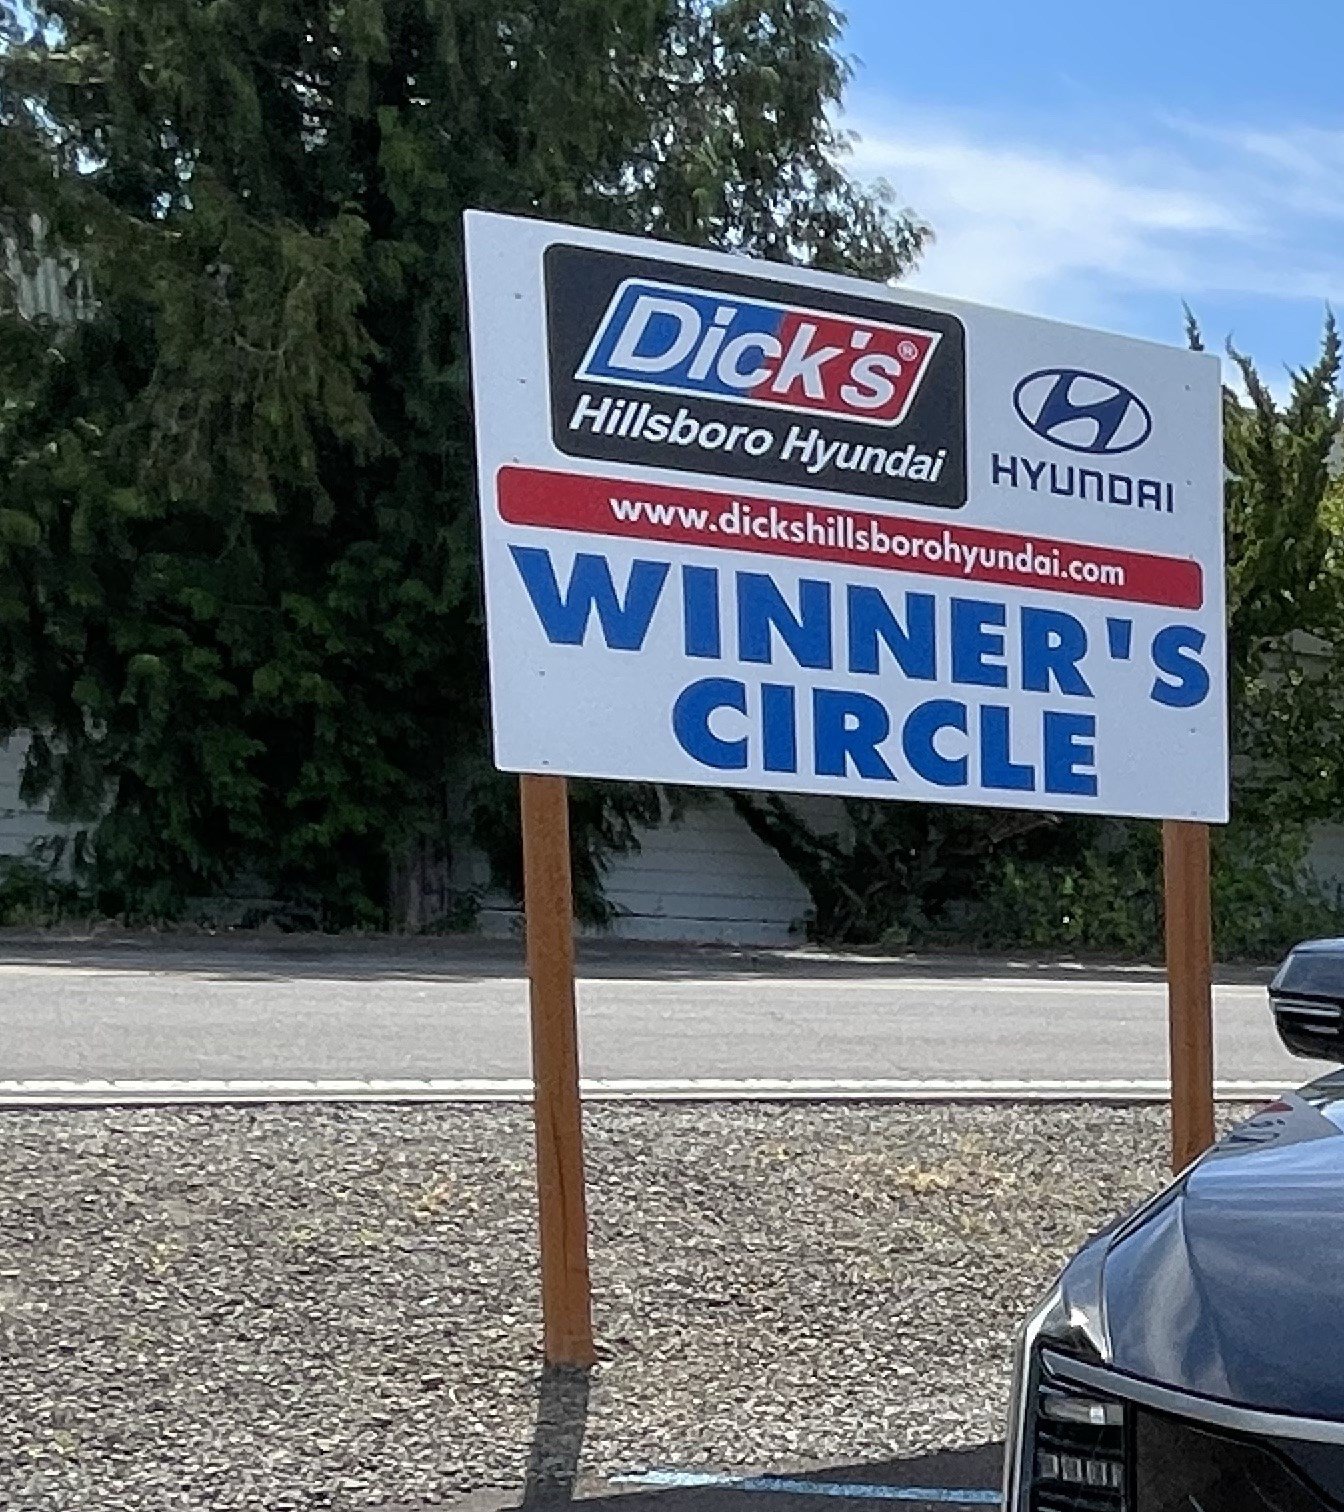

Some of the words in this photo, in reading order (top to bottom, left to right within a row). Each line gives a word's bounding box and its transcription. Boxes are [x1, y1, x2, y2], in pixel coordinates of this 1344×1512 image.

[608, 294, 902, 409] Dick's
[569, 395, 774, 460] Hillsboro
[780, 426, 947, 484] Hyundai
[992, 453, 1174, 513] HYUNDAI
[610, 498, 1125, 588] www.dickshillsborohyundai.com
[508, 544, 1210, 708] WINNER'S
[672, 678, 1099, 797] CIRCLE
